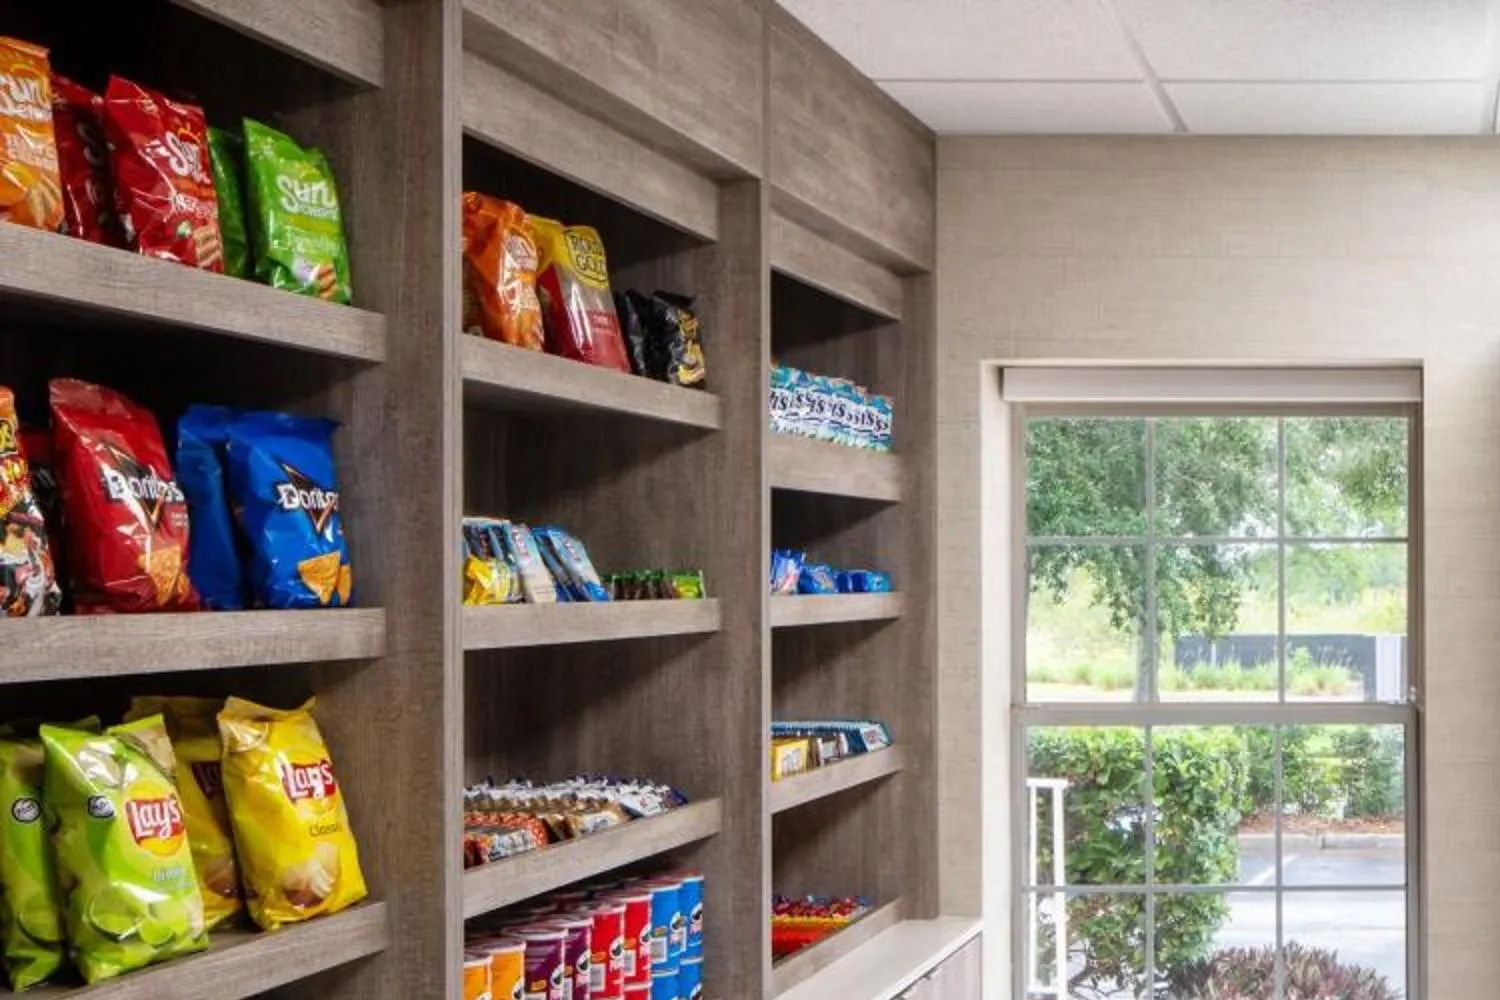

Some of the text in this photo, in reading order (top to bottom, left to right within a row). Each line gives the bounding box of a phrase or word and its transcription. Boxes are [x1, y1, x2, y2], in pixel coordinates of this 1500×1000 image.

[101, 466, 185, 503] Doritos
[283, 762, 334, 799] Lay's
[127, 798, 181, 840] Lay's
